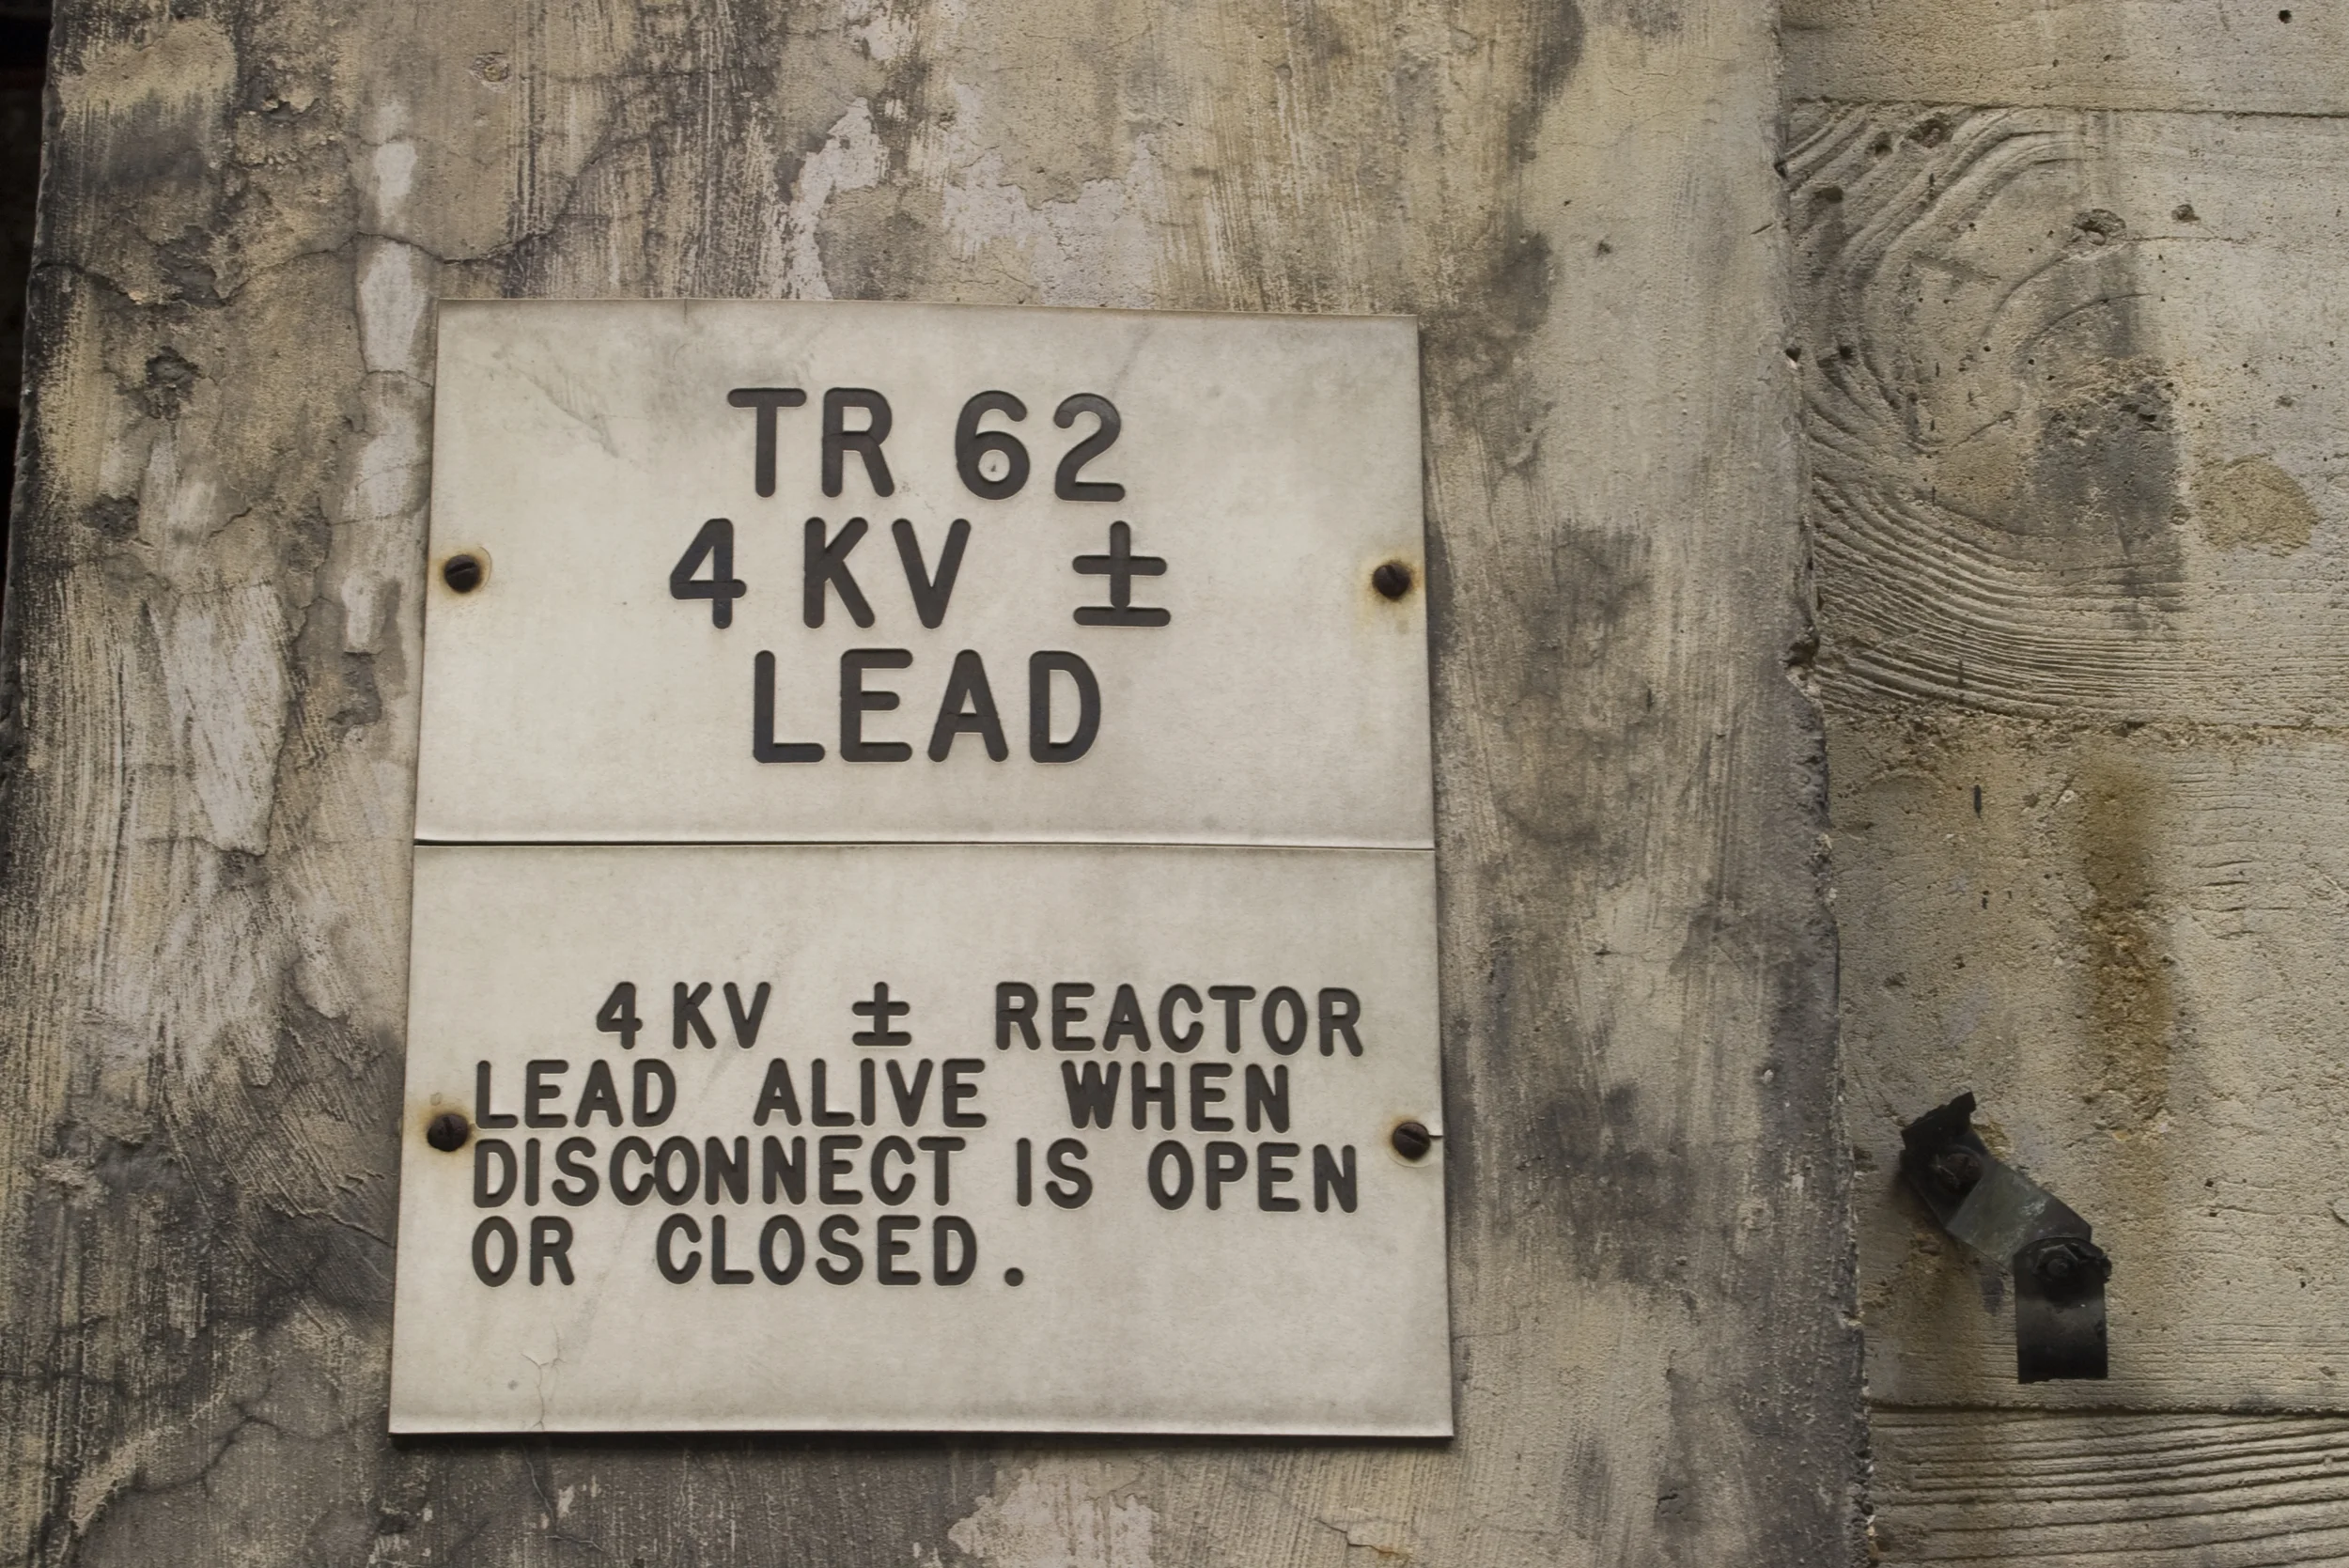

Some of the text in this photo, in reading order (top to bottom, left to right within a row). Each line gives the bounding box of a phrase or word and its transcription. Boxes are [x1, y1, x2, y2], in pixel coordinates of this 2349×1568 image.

[725, 385, 1128, 504] TR 62
[668, 517, 748, 631] 4
[801, 515, 972, 631] KV
[751, 646, 1103, 765] LEAD
[595, 980, 645, 1051] 4
[671, 980, 773, 1051] KV
[994, 980, 1365, 1059] REACTOR
[474, 1056, 1292, 1135] LEAD ALIVE WHEN
[472, 1133, 1360, 1215] DISCONNECT IS OPEN
[470, 1214, 576, 1289] OR
